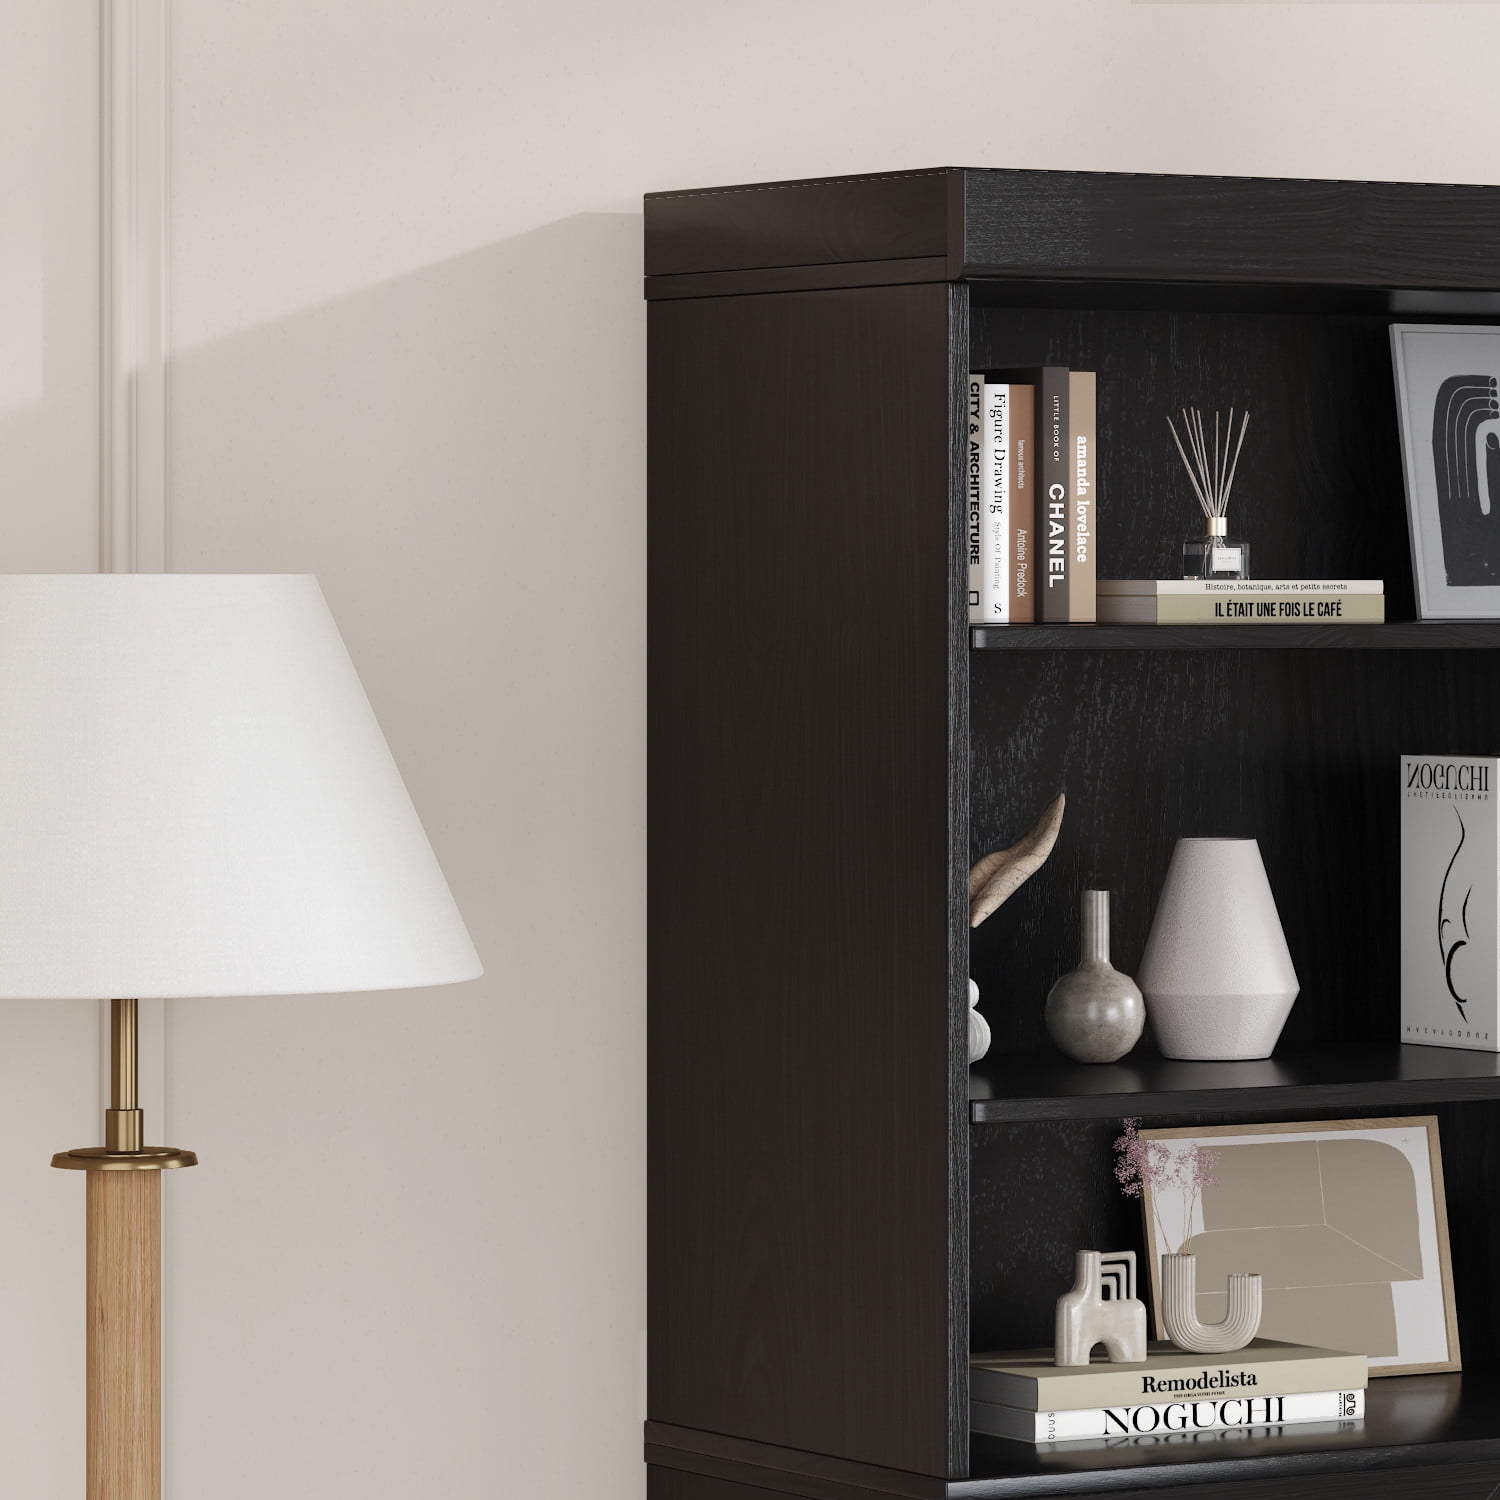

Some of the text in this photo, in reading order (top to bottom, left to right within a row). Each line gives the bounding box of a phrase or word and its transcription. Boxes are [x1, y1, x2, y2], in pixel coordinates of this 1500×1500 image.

[969, 382, 980, 565] CITY & ARCHITECTURE
[989, 393, 1006, 514] Figure Drawing
[1017, 439, 1025, 489] famous architects
[1053, 450, 1060, 462] OF
[1076, 435, 1090, 563] amanda lovelace
[1048, 483, 1065, 588] CHANEL
[993, 557, 1002, 590] Painting
[1016, 528, 1028, 597] Antoine Predock
[1205, 583, 1348, 593] Histoire, botanique, arts et petits secrets
[1215, 599, 1342, 617] IL ÉTAIT UNE FOIS LE CAFÉ
[1141, 1369, 1258, 1394] Remodelista
[1102, 1396, 1286, 1436] NOGUCHI
